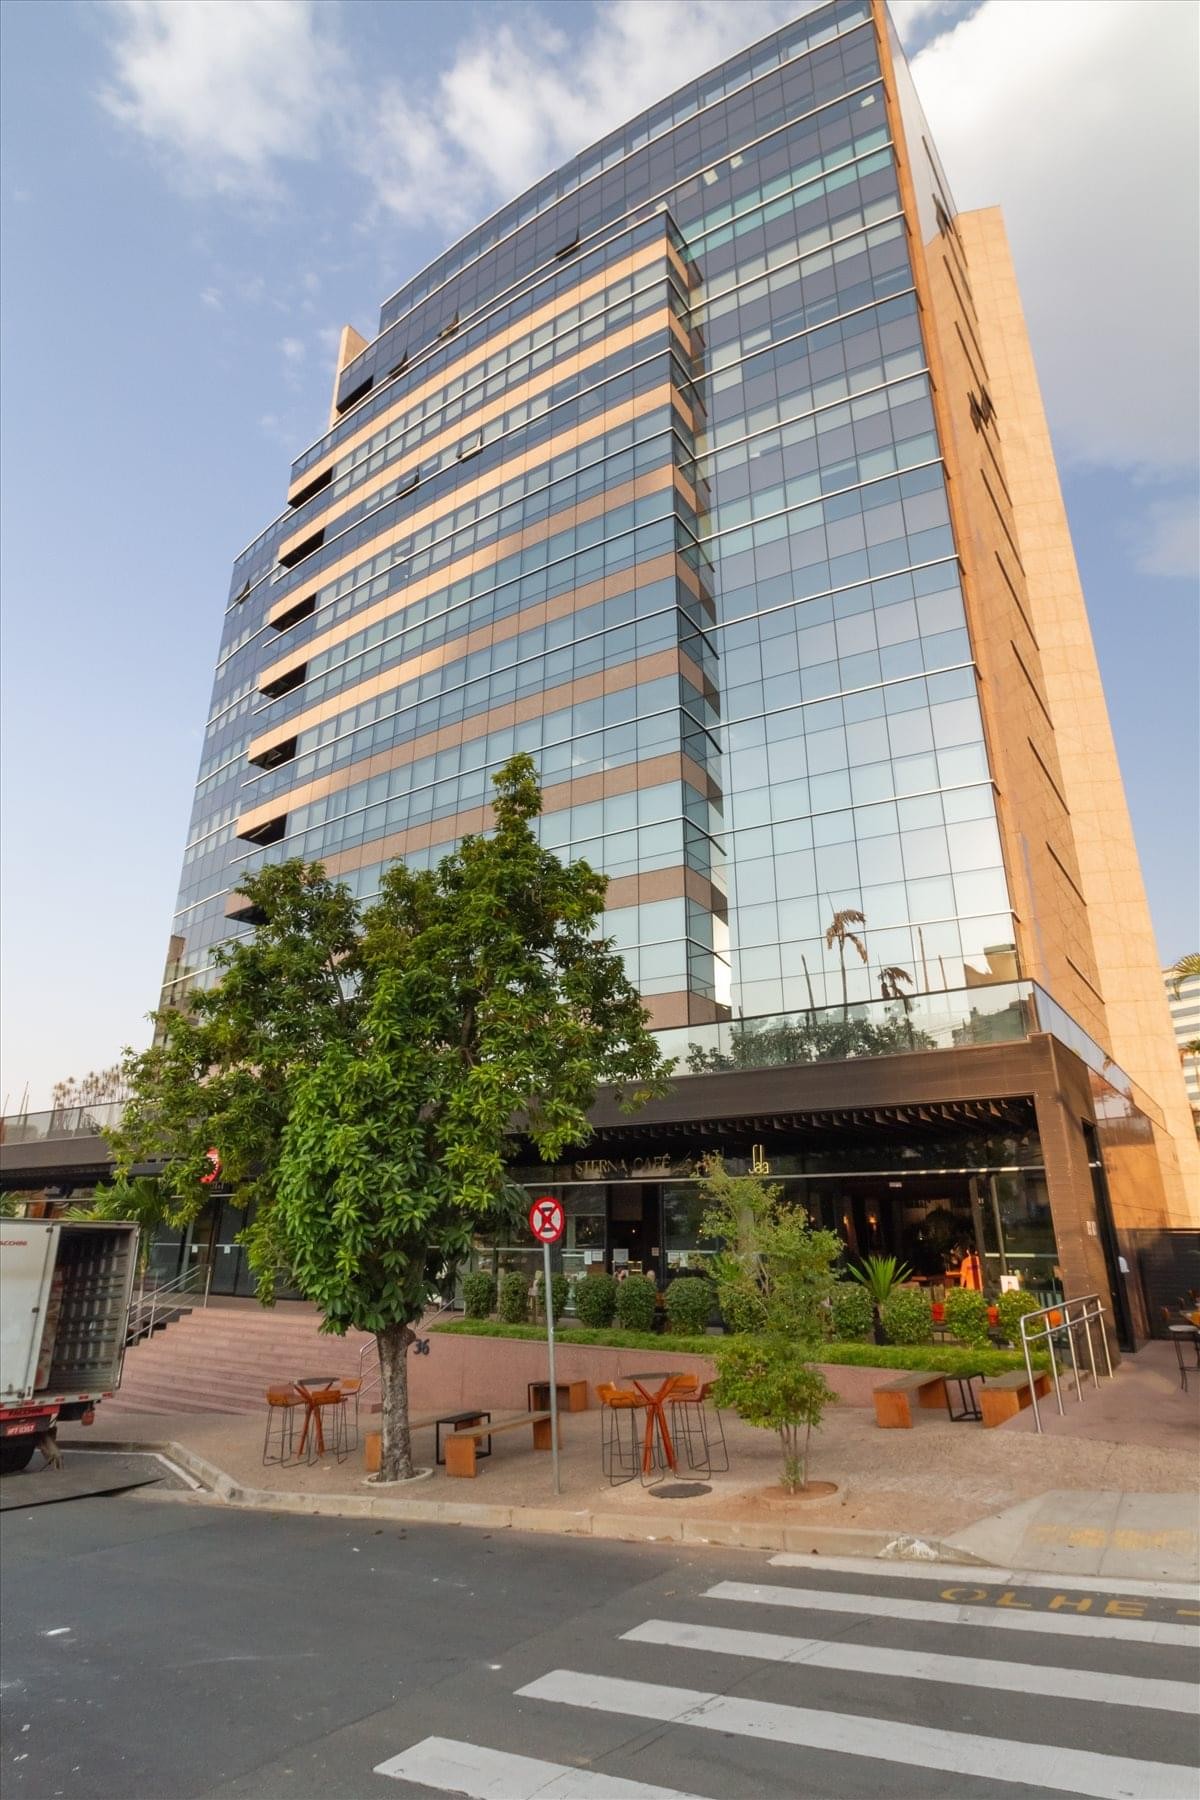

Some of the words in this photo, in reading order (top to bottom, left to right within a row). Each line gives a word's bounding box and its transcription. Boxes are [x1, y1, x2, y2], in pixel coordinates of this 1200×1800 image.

[575, 1159, 629, 1175] STERNA
[633, 1153, 671, 1171] CAFÉ
[939, 1586, 1149, 1618] OLHE
